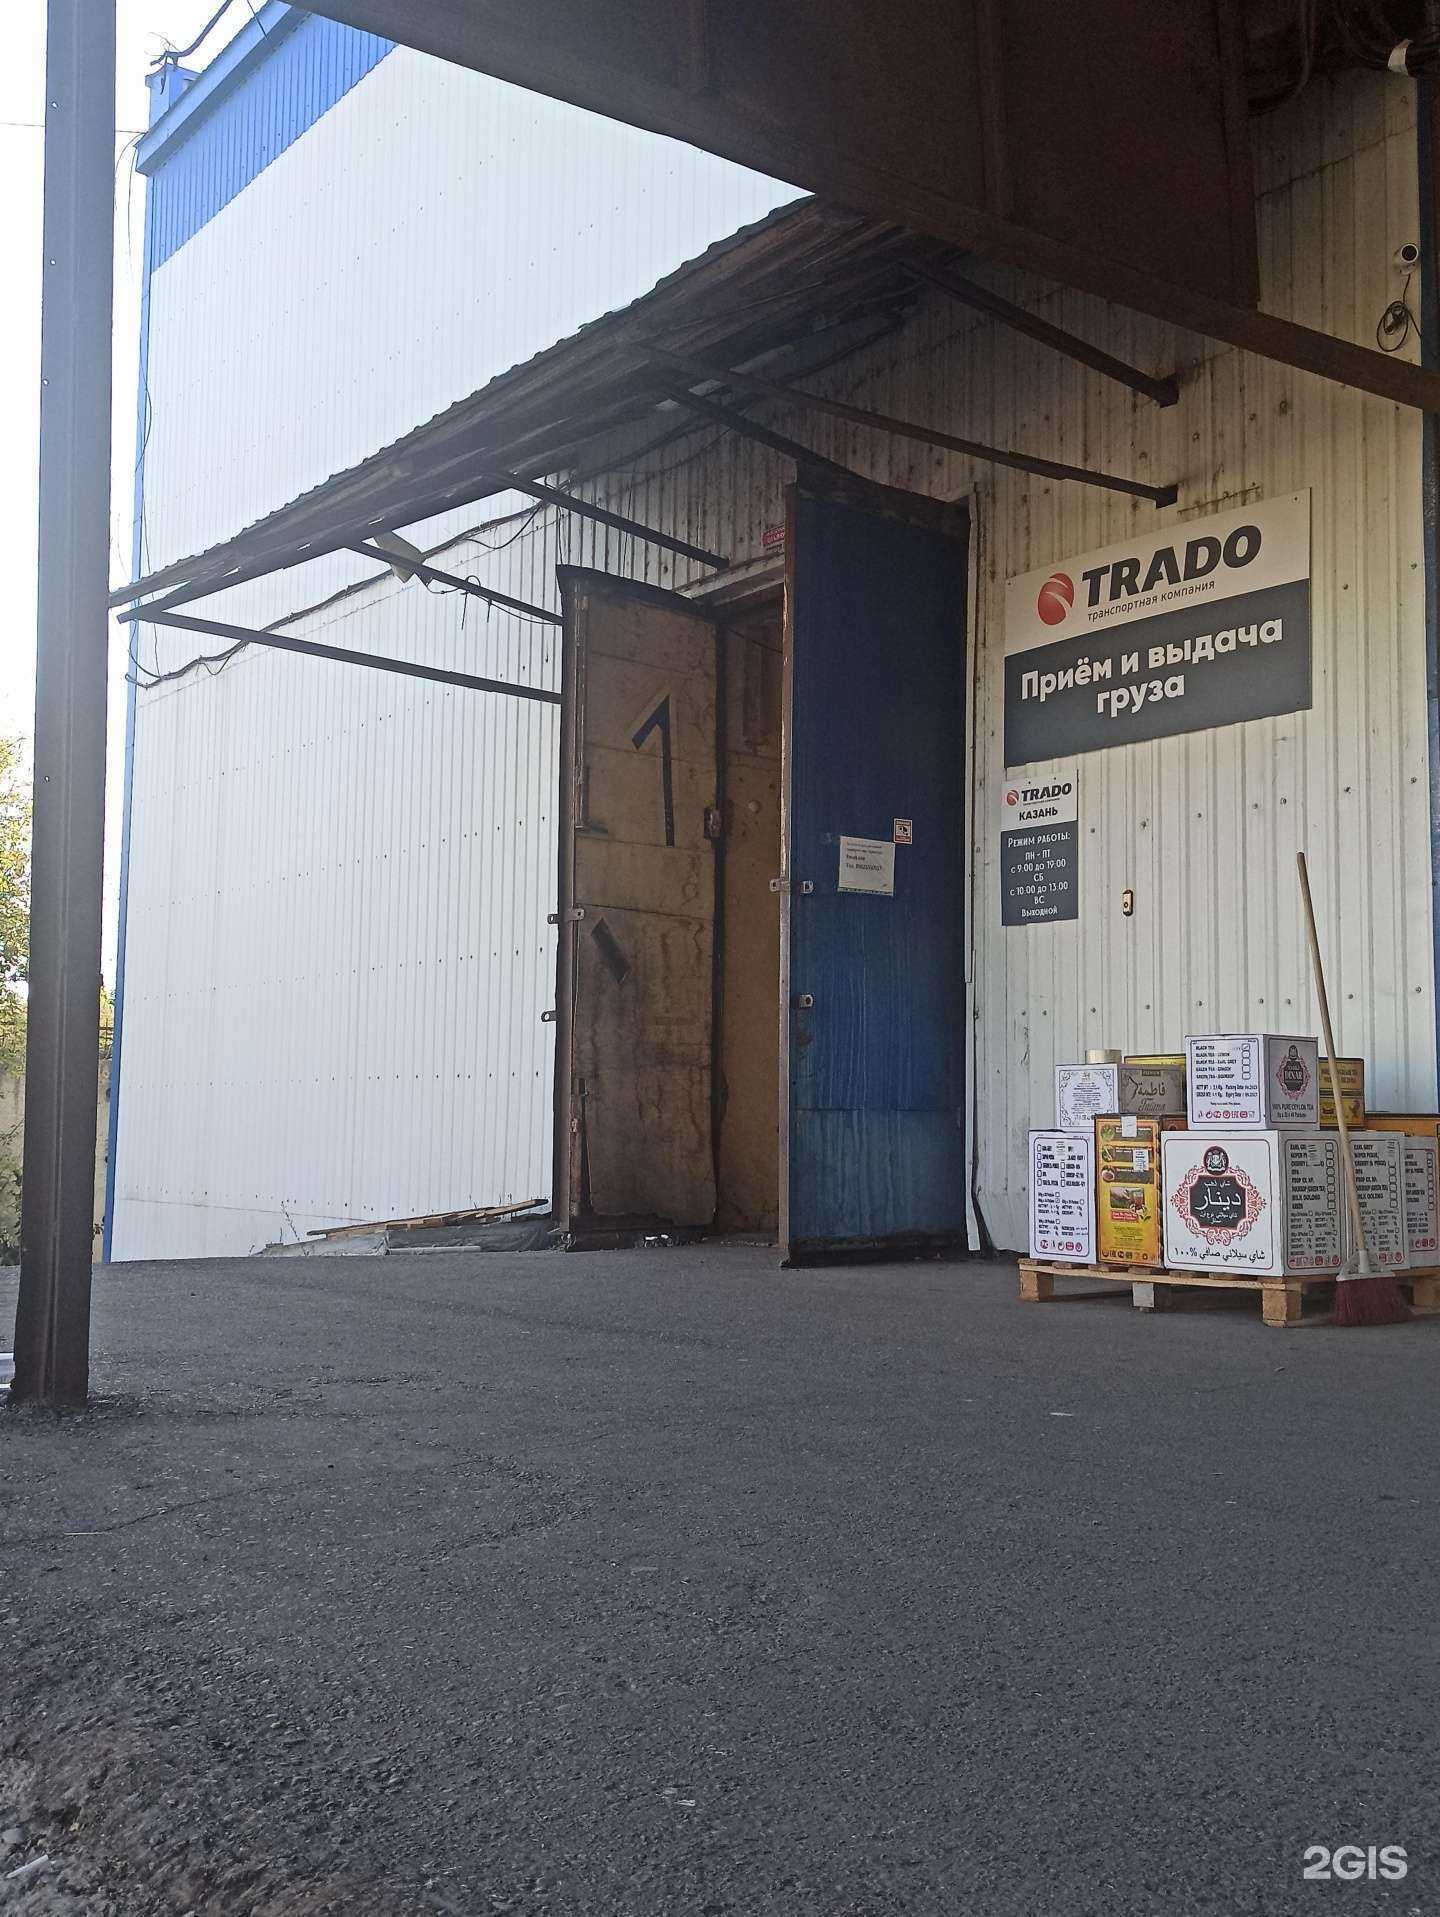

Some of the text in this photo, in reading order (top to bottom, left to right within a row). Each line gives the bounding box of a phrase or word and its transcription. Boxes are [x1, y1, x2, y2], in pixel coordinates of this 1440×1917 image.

[1081, 525, 1262, 607] TRADO
[1087, 580, 1215, 622] транспортная компания
[1021, 618, 1283, 701] Приём и выдача
[1097, 675, 1185, 718] груза
[1021, 783, 1072, 802] TRADO
[1019, 807, 1058, 821] КАЗАНЬ
[1025, 851, 1035, 860] ПН
[1042, 849, 1051, 859] ПТ
[1035, 863, 1045, 871] до
[1033, 872, 1044, 881] СБ
[1037, 886, 1047, 894] до
[1034, 895, 1045, 905] ВС
[1194, 1187, 1242, 1211] دينار
[1249, 1249, 1265, 1264] شاي
